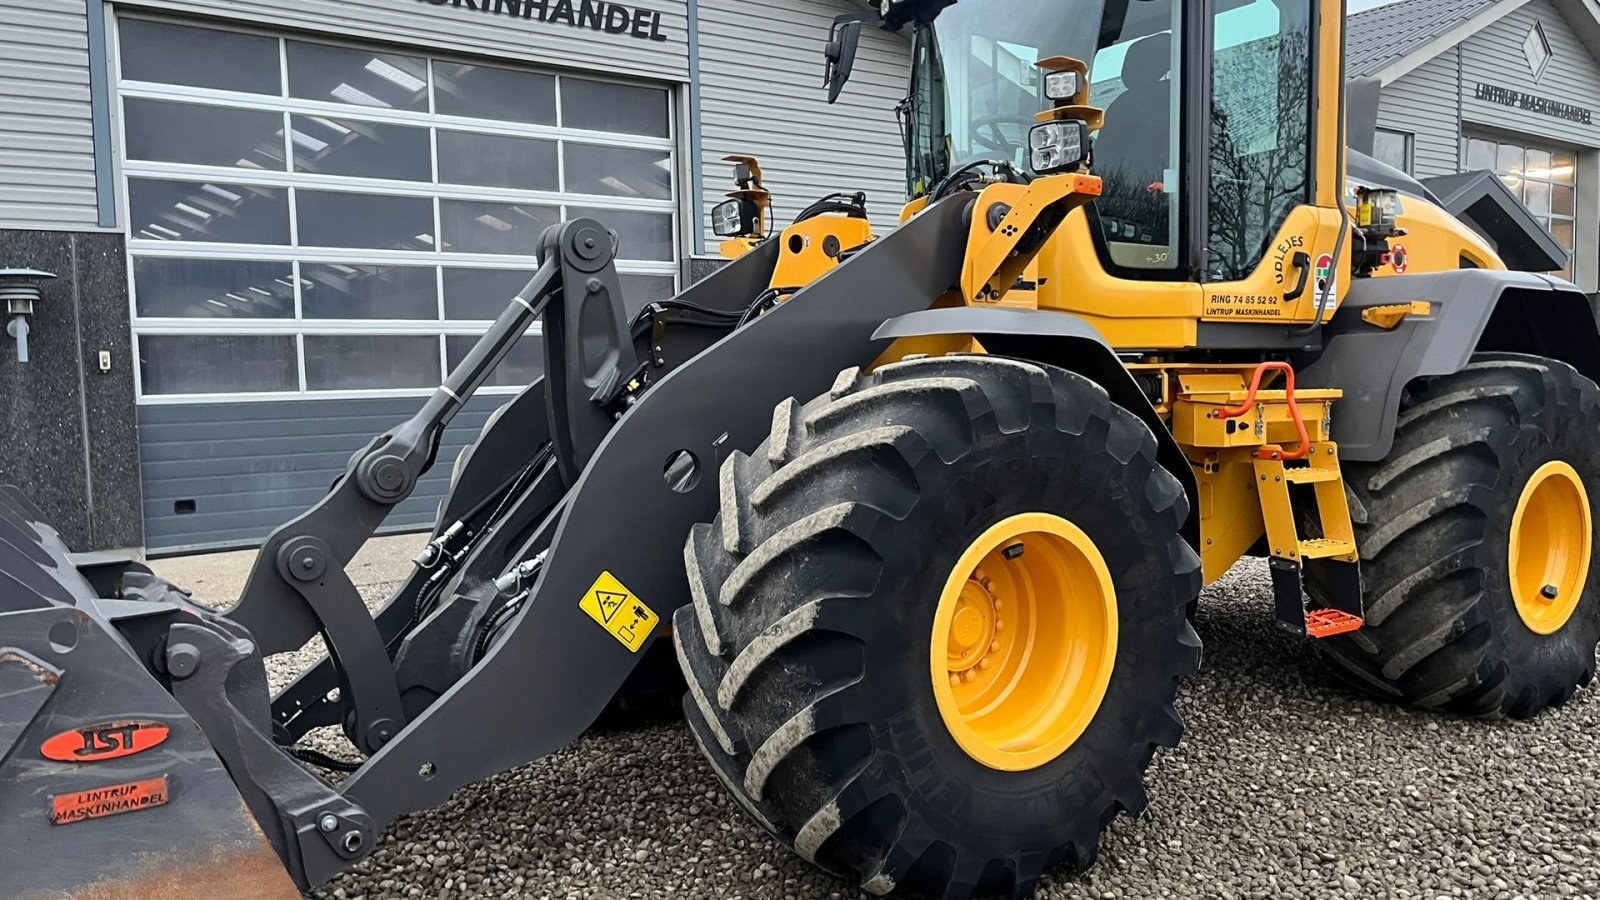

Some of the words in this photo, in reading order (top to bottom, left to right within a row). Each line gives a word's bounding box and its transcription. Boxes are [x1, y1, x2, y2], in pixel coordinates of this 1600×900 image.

[1274, 236, 1304, 284] UDLEJES
[1211, 294, 1231, 304] RING
[1233, 295, 1243, 304] 74
[1256, 296, 1267, 305] 52
[1268, 296, 1278, 305] 92
[1206, 307, 1234, 316] LINTRUP
[1234, 308, 1281, 316] MASKINHANDEL
[78, 785, 138, 804] LINTRUP
[54, 793, 164, 820] MASKINHANDEL
